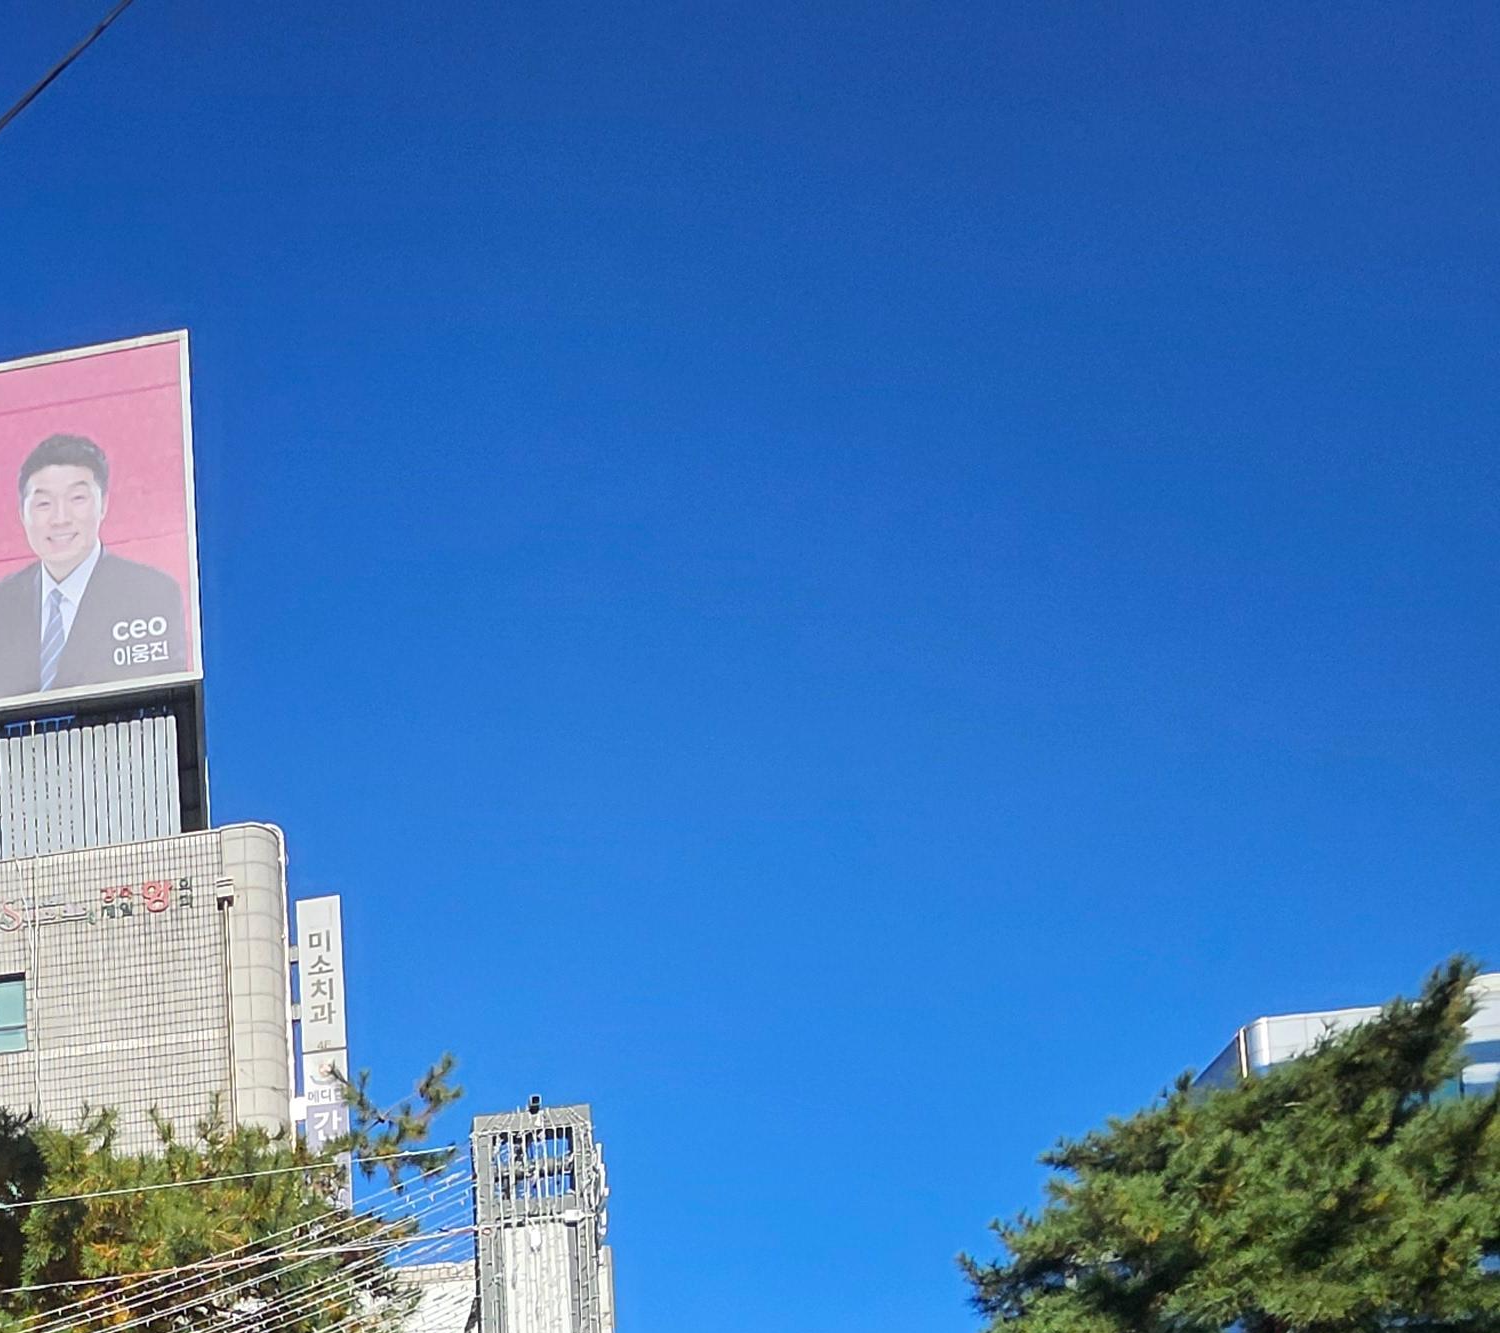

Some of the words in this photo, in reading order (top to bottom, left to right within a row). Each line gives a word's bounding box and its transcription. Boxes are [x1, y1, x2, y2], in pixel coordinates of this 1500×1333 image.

[112, 614, 167, 642] ceo
[113, 641, 170, 667] 이웅진
[308, 930, 337, 1025] 미소치과
